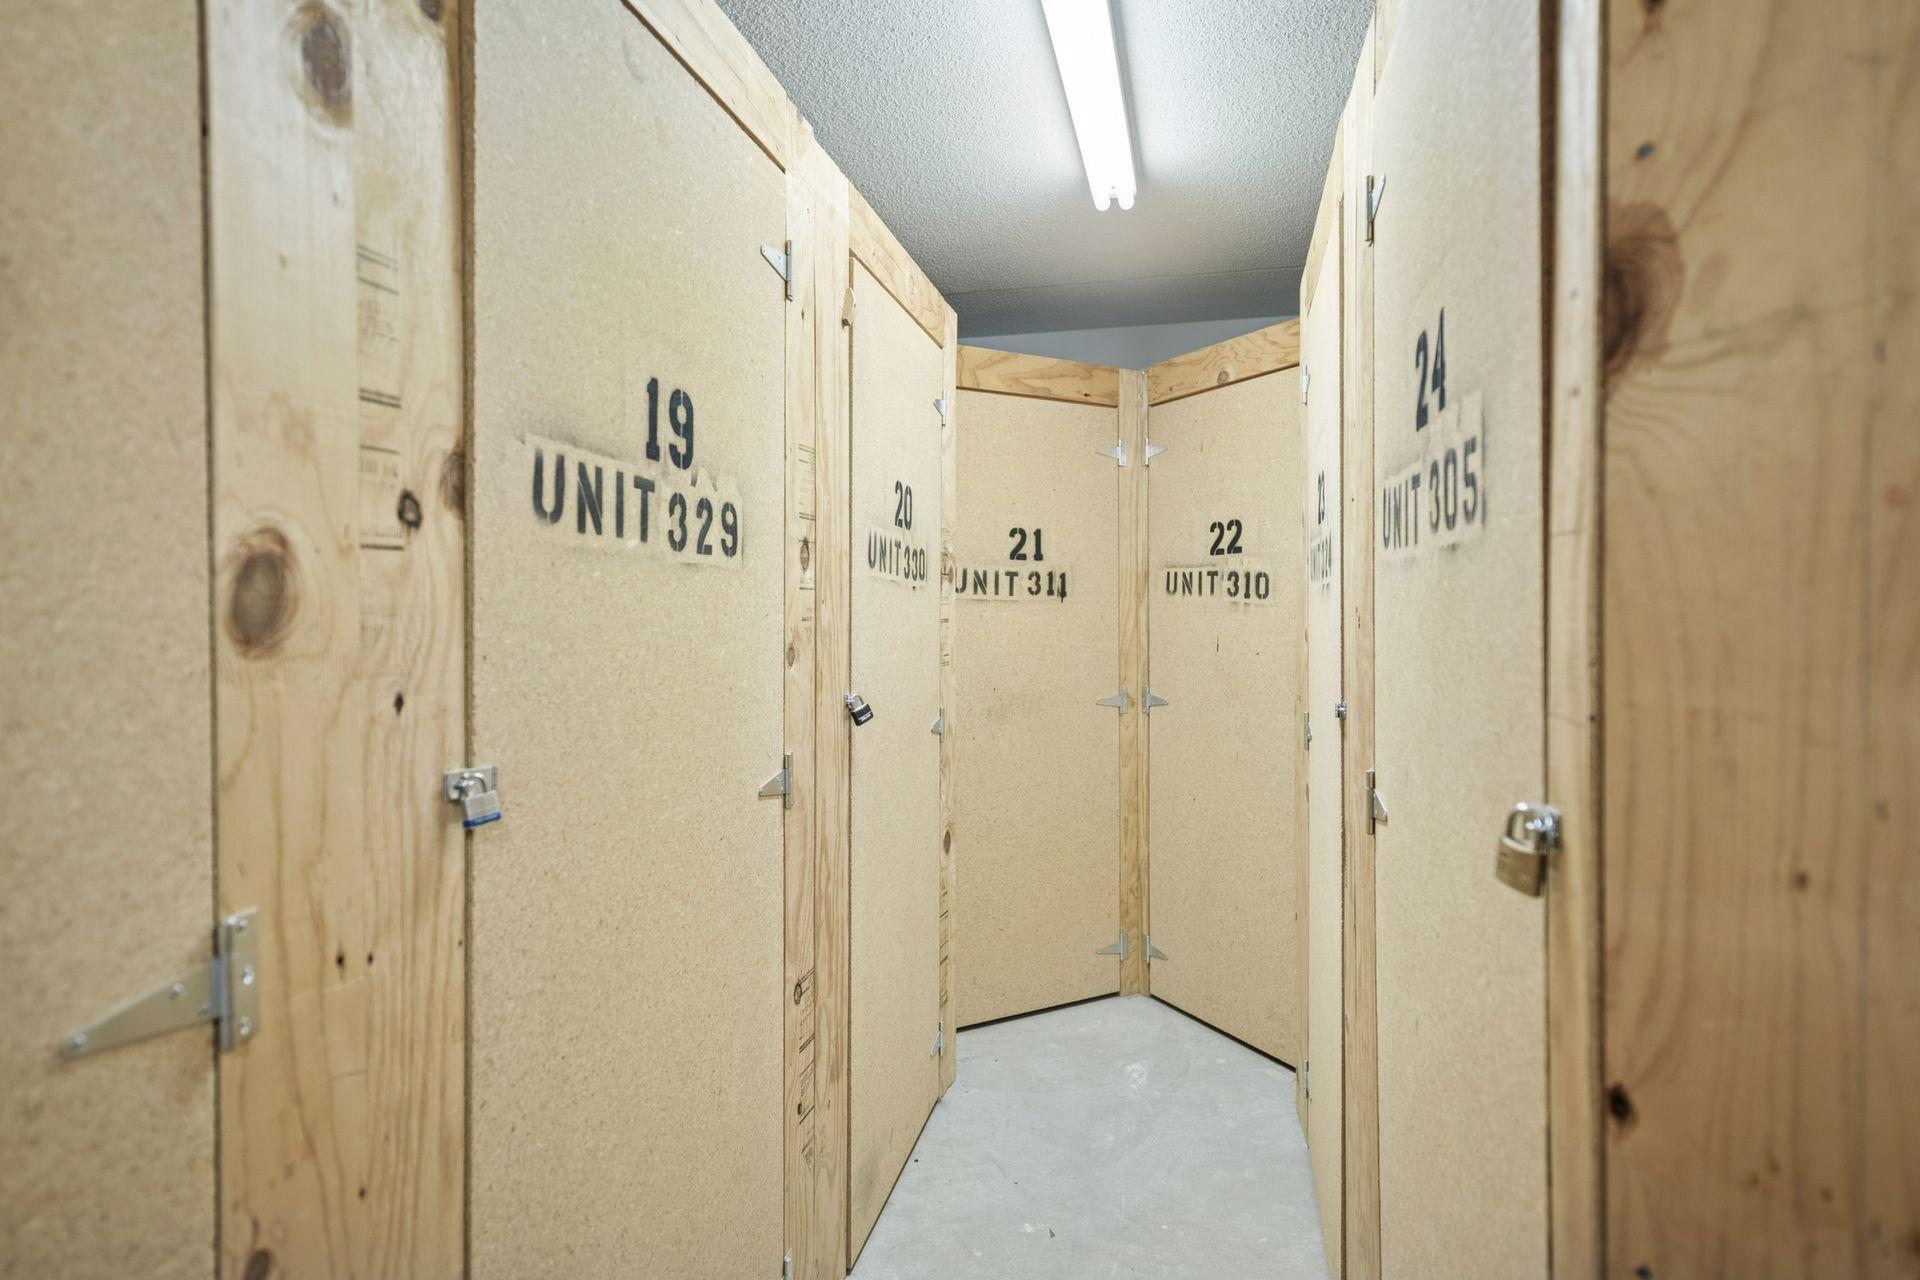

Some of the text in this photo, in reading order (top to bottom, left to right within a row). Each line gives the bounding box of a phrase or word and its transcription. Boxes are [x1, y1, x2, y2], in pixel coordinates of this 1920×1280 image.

[1415, 306, 1446, 432] 24
[645, 377, 694, 470] 19
[532, 448, 738, 558] UNIT 329
[894, 480, 913, 530] 20
[1383, 436, 1478, 550] UNIT 305
[867, 530, 926, 582] UNIT 330
[1009, 527, 1044, 561] 21
[1209, 519, 1243, 556] 22
[955, 568, 1067, 601] UNIT 311
[1165, 571, 1270, 600] UNIT 310
